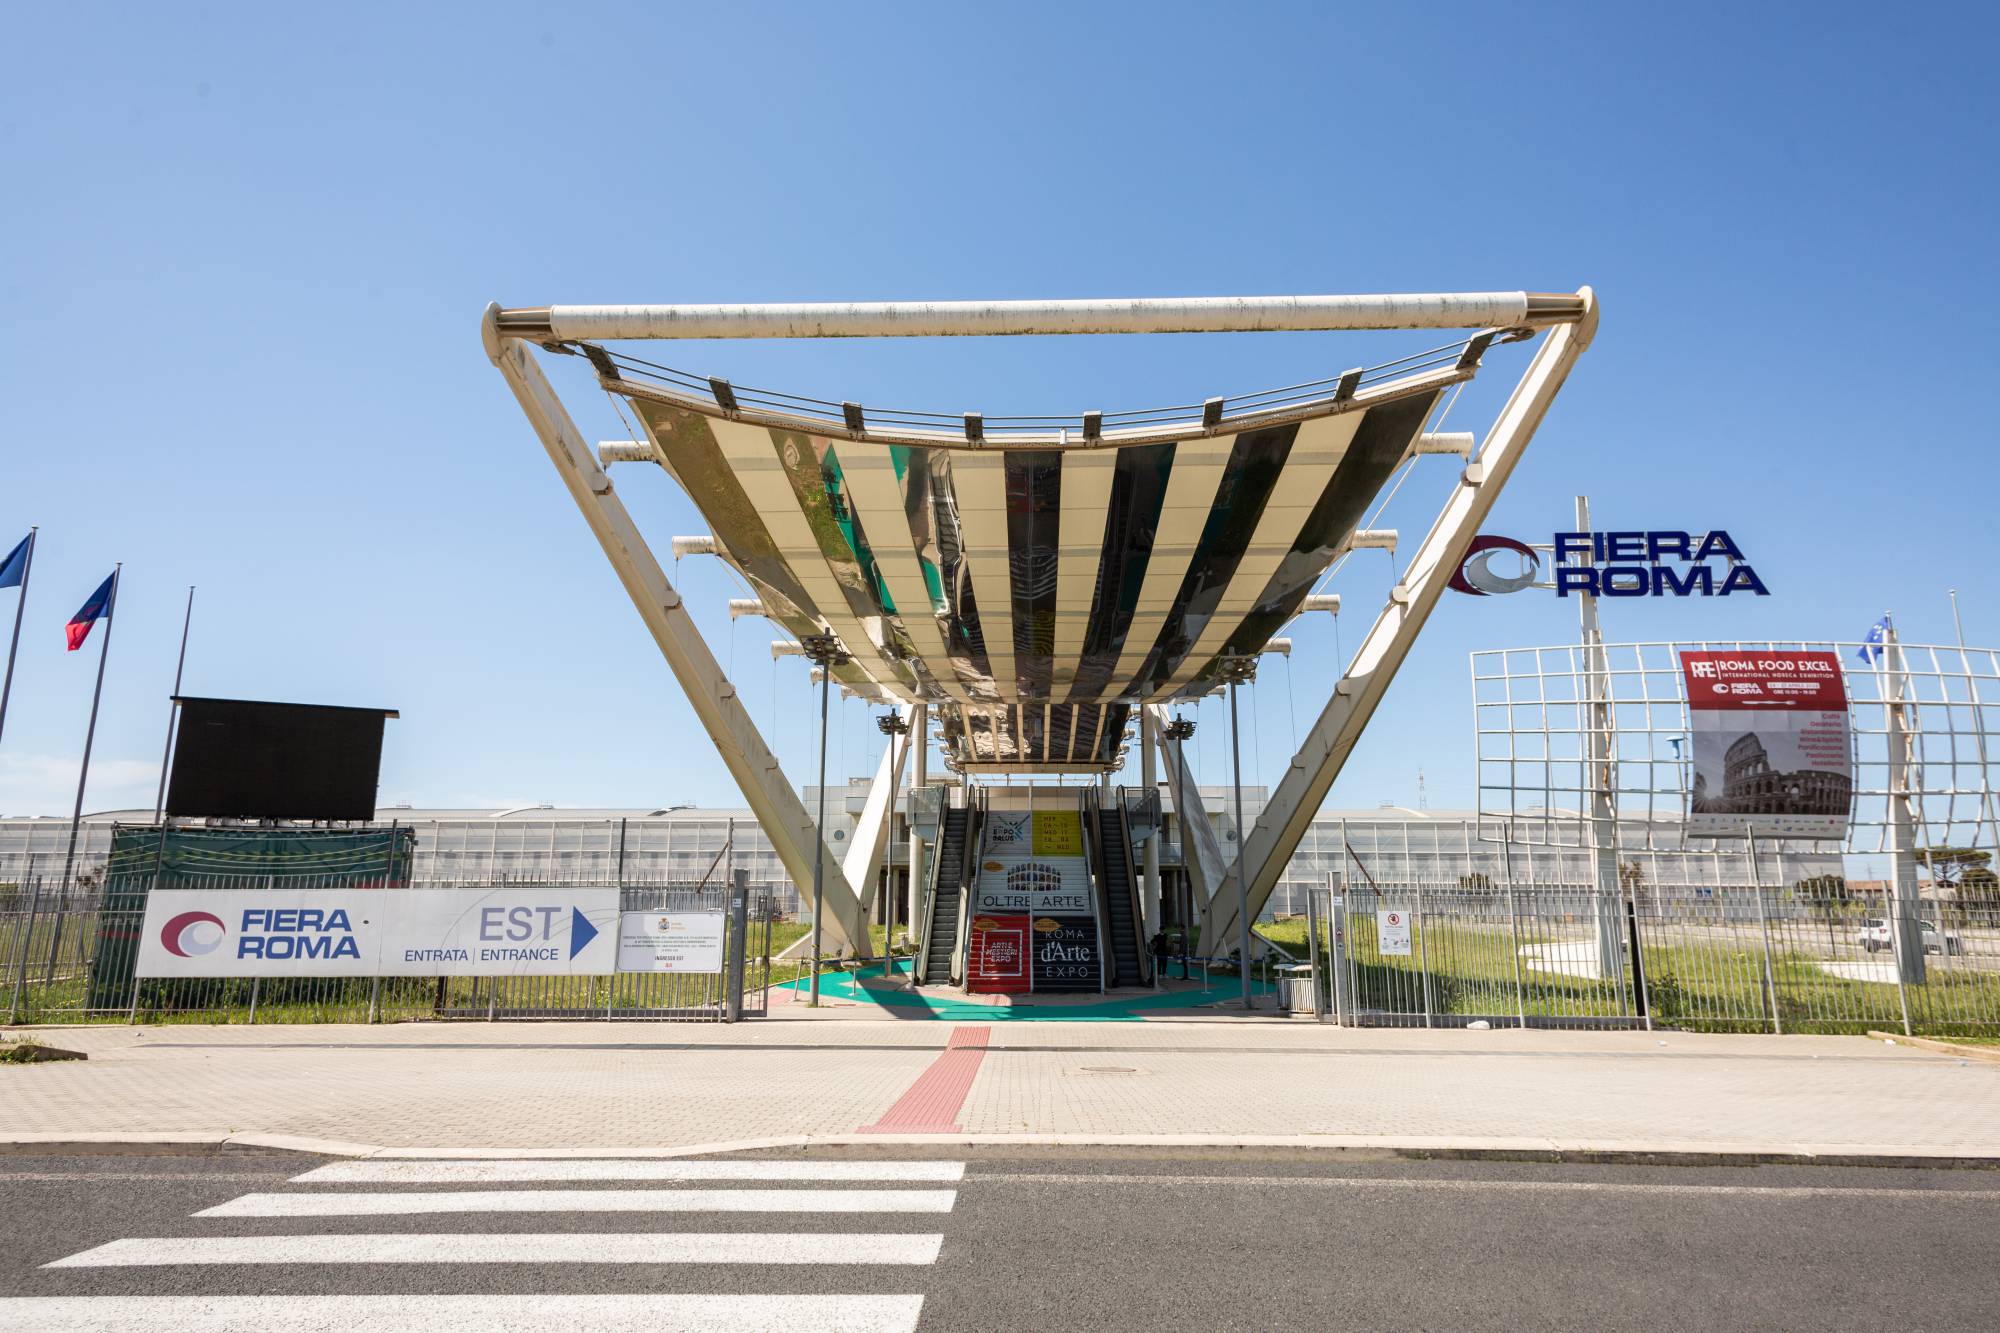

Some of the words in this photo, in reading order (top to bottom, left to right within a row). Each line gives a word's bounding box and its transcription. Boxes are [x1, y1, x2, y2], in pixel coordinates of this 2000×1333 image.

[1553, 530, 1745, 562] FIERA
[1556, 565, 1771, 597] ROMA
[1690, 661, 1717, 678] RFE
[1719, 660, 1755, 671] ROMA
[1758, 660, 1795, 671] FOOD
[1798, 661, 1832, 671] EXCEL
[983, 895, 1030, 907] OLTRE
[1041, 895, 1085, 907] ARTE
[241, 909, 352, 932] FIERA
[480, 906, 562, 941] EST
[1045, 929, 1084, 939] ROMA
[237, 936, 360, 959] ROMA
[405, 950, 468, 962] ENTRATA
[481, 949, 559, 961] ENTRANCE
[1041, 941, 1090, 962] d'Arte
[1046, 967, 1088, 977] EXPO
